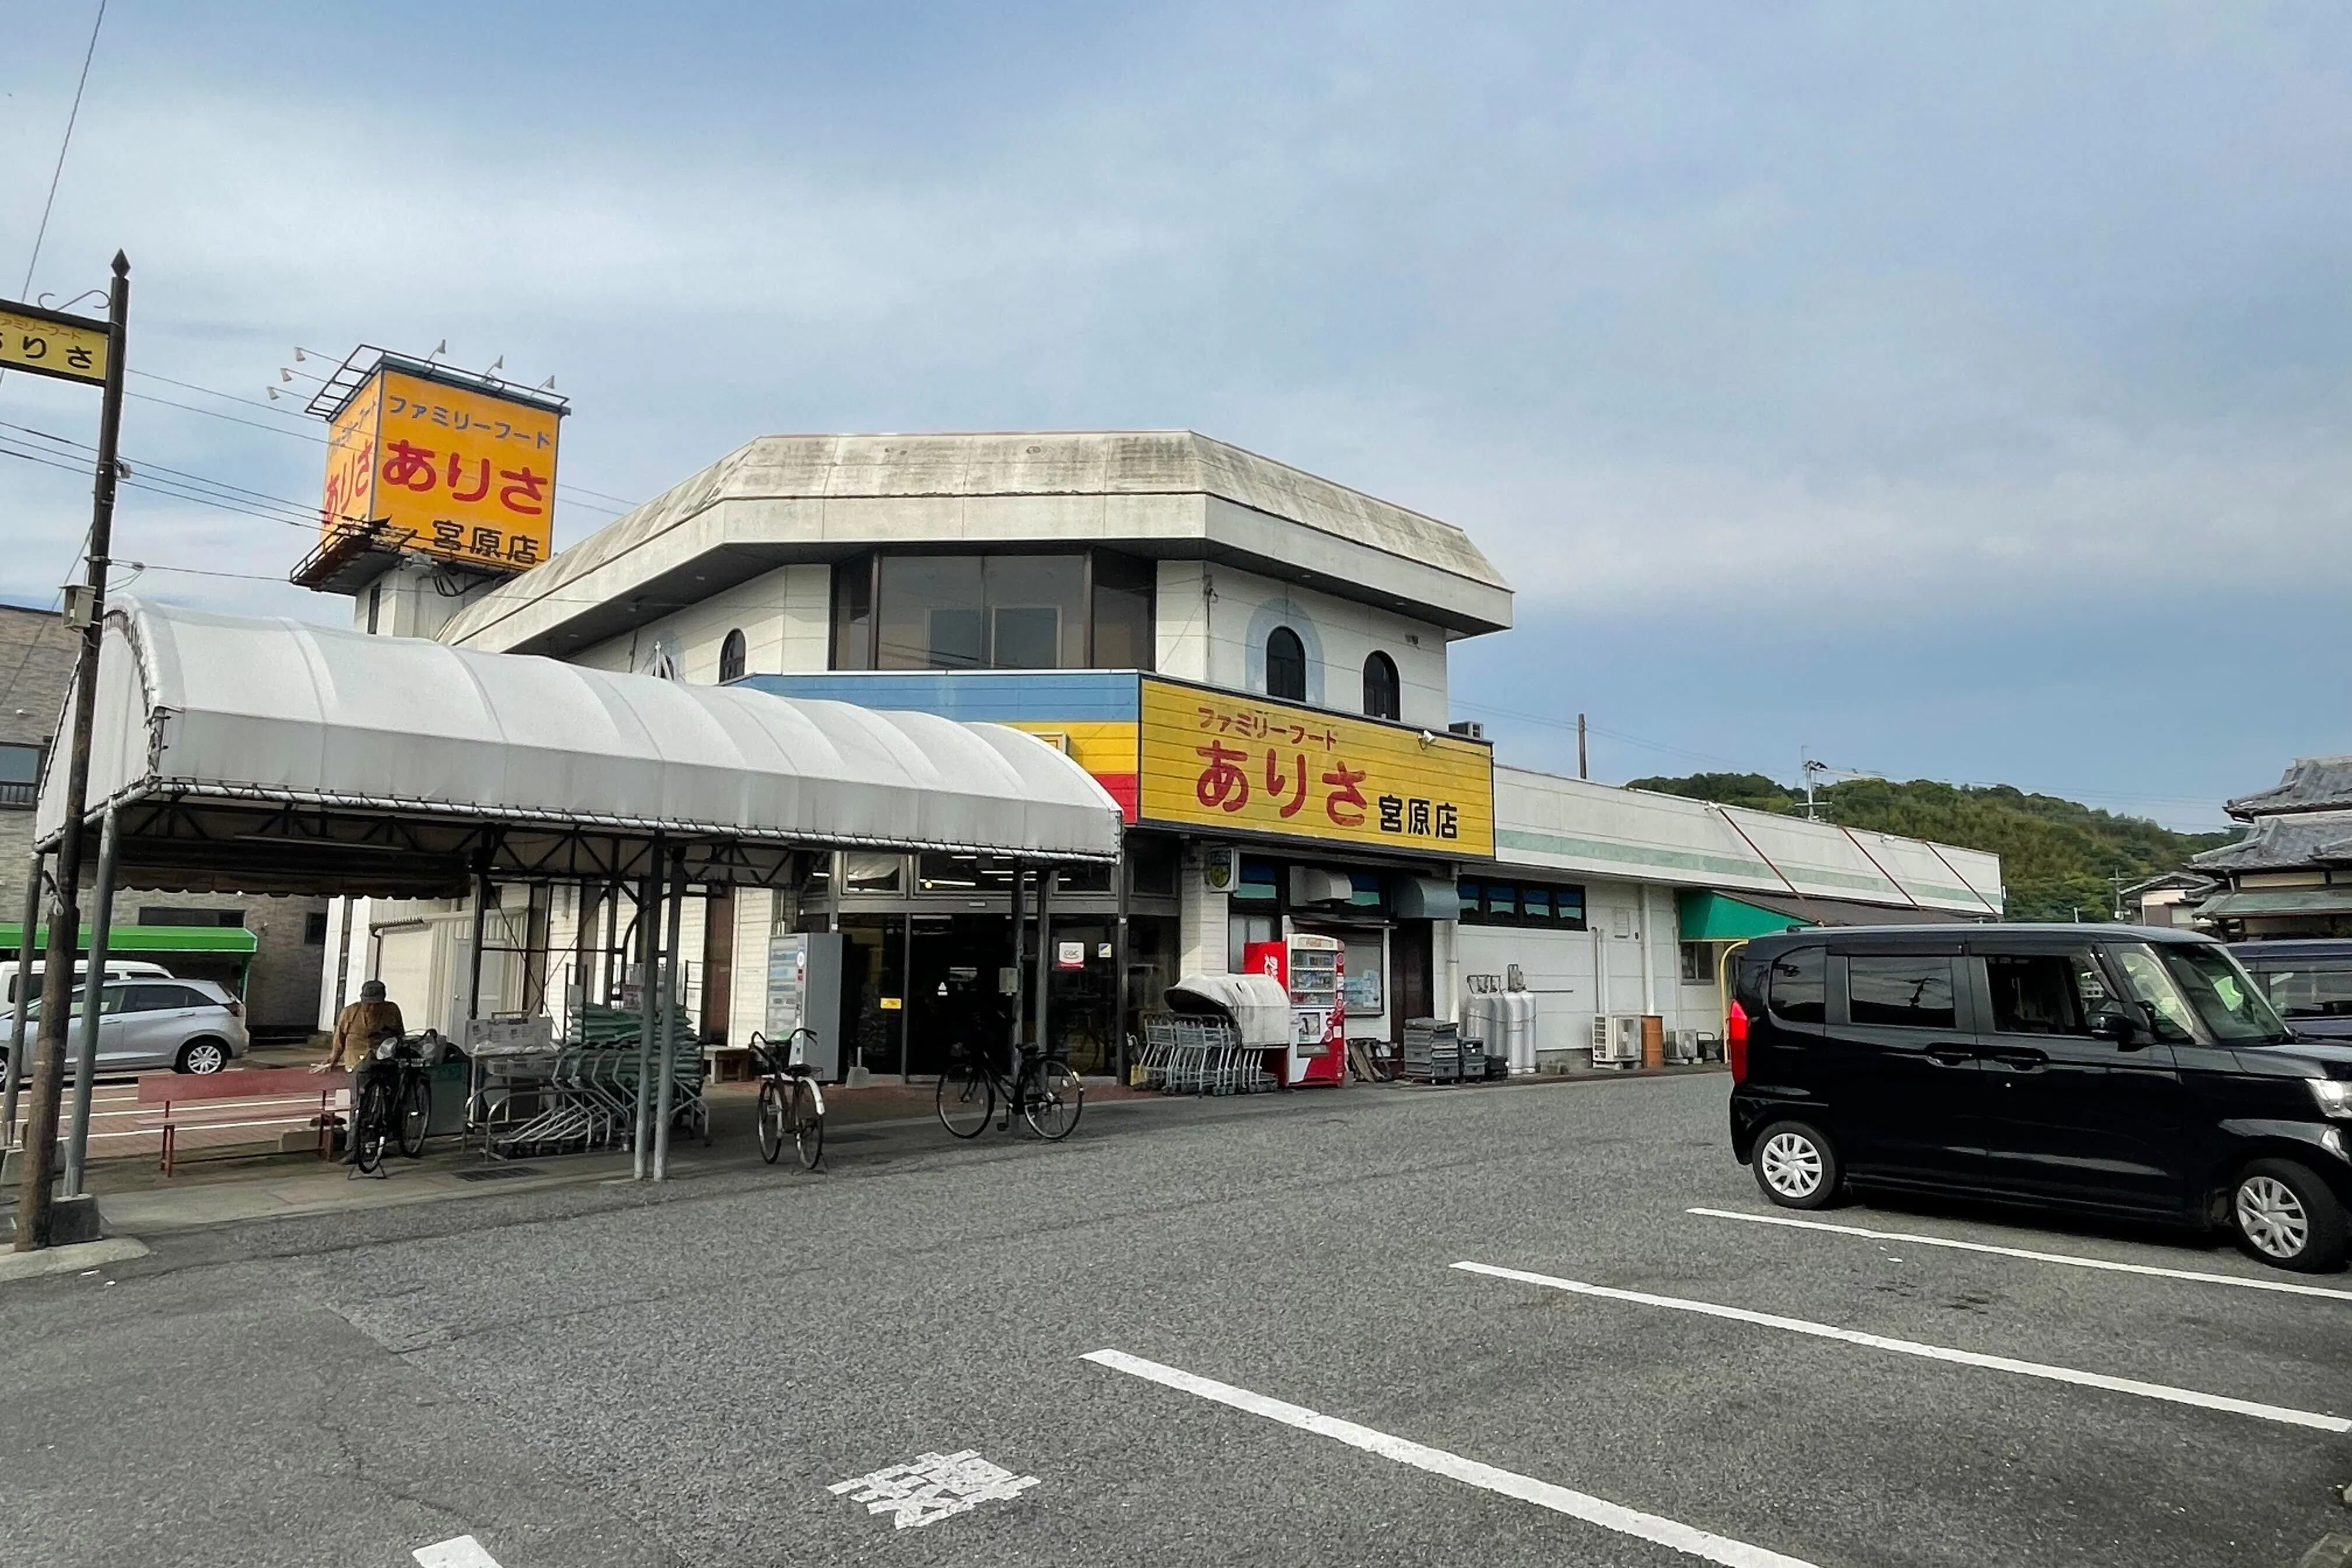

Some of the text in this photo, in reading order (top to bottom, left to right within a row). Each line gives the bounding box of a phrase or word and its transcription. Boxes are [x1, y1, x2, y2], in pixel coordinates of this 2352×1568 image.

[0, 332, 92, 369] りさ
[388, 396, 551, 449] ファミリーフード
[382, 439, 548, 515] ありさ
[432, 519, 538, 564] 宮原店
[1196, 740, 1458, 839] ありさ 宮原店
